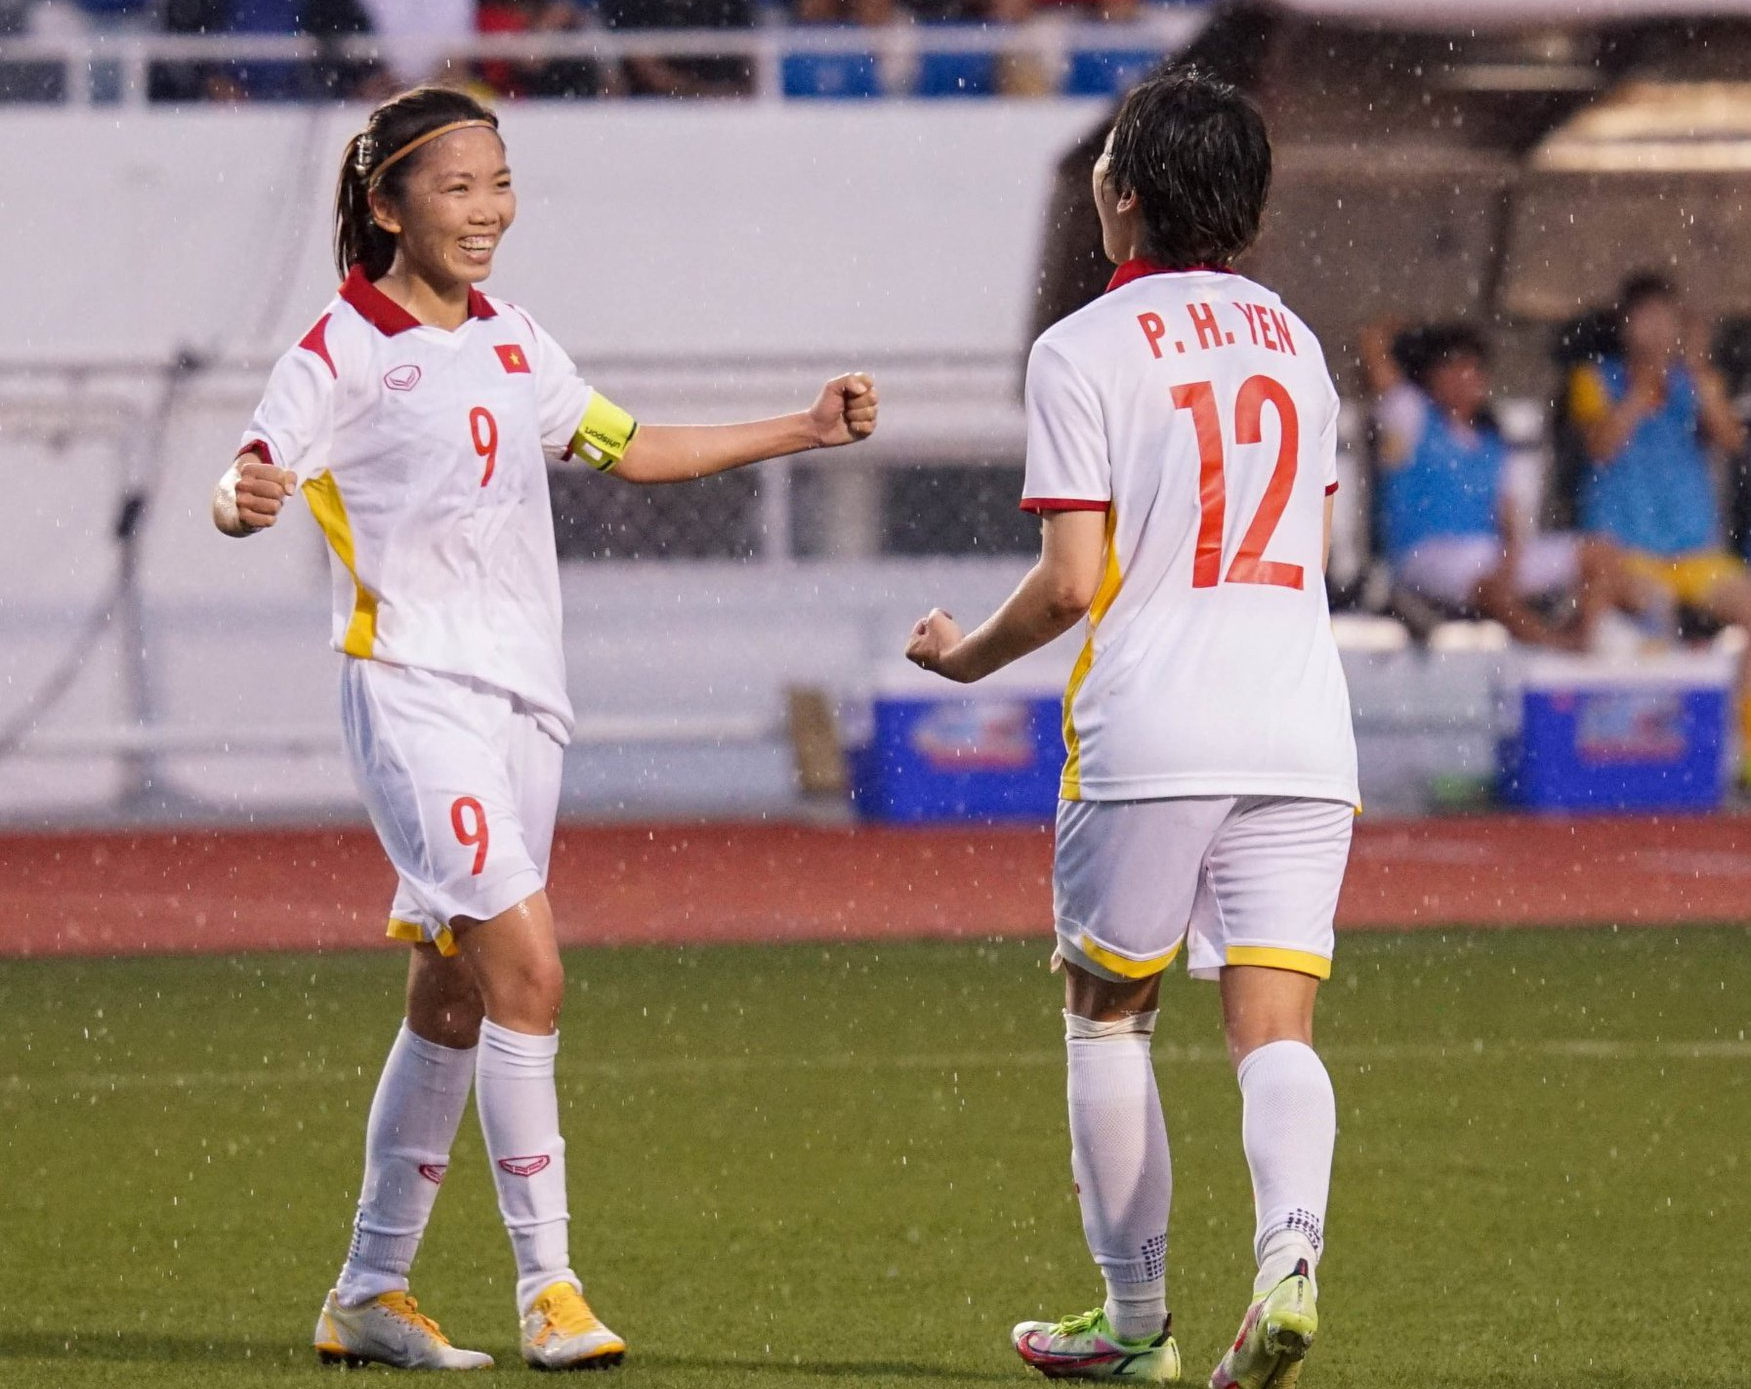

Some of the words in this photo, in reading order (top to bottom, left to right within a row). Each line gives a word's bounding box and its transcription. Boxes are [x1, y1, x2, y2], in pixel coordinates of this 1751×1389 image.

[1137, 312, 1185, 359] P.
[1187, 302, 1236, 350] H.
[1236, 302, 1297, 357] YEN
[469, 406, 498, 488] 9
[1170, 374, 1304, 591] 12
[451, 796, 489, 876] 9
